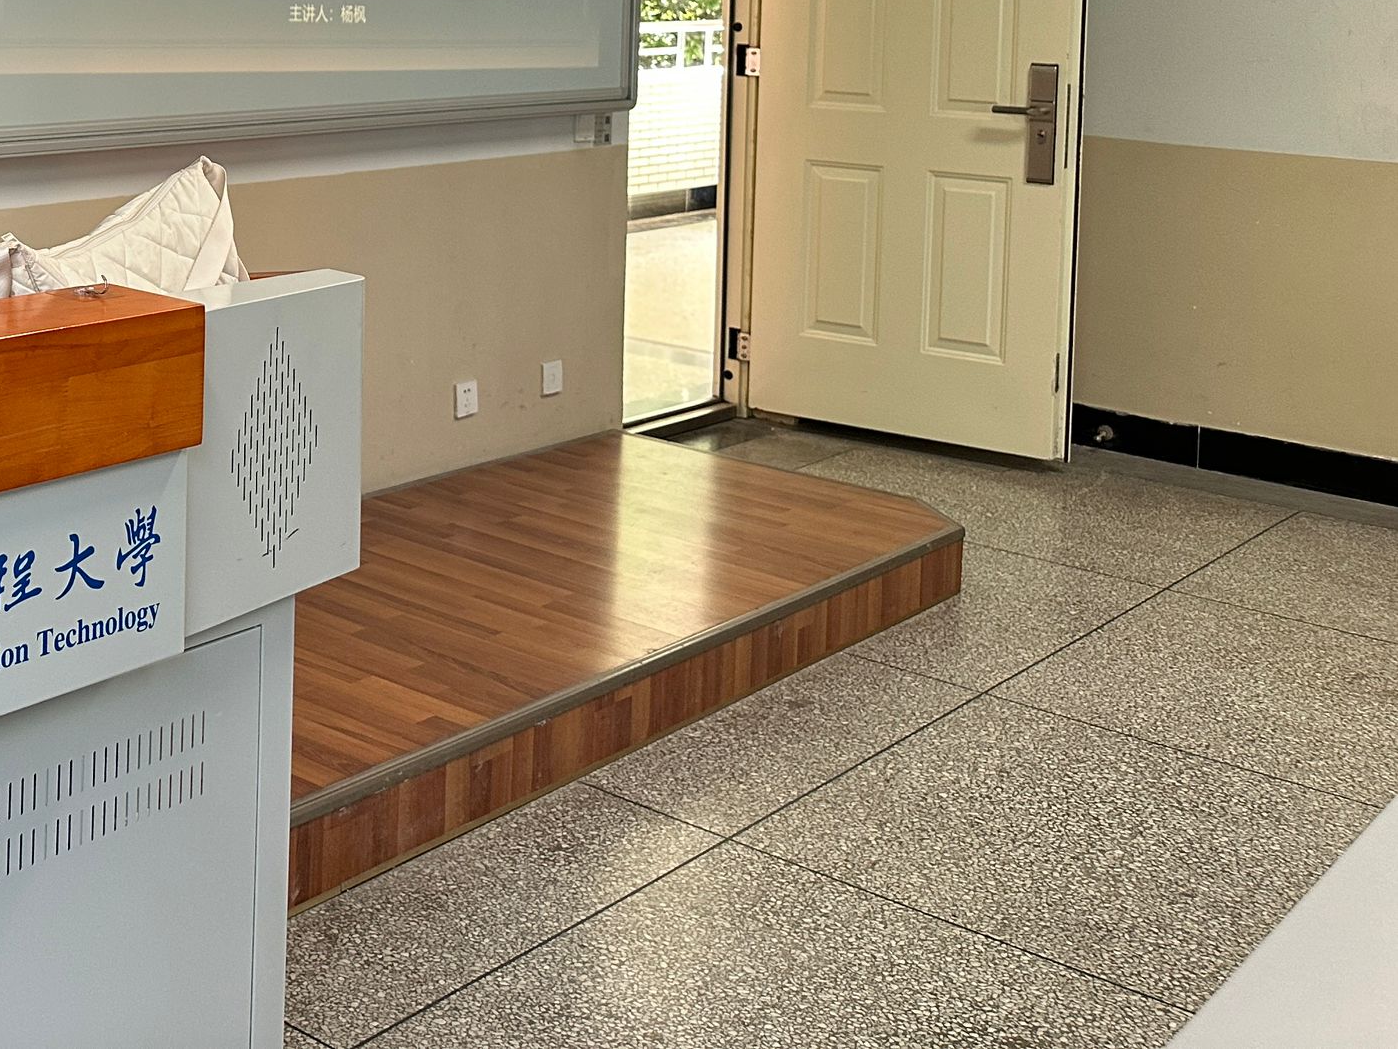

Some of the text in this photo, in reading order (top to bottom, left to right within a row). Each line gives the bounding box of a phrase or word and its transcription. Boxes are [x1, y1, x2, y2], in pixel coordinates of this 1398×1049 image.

[288, 4, 367, 24] 主讲人：杨枫
[36, 602, 161, 658] Technology
